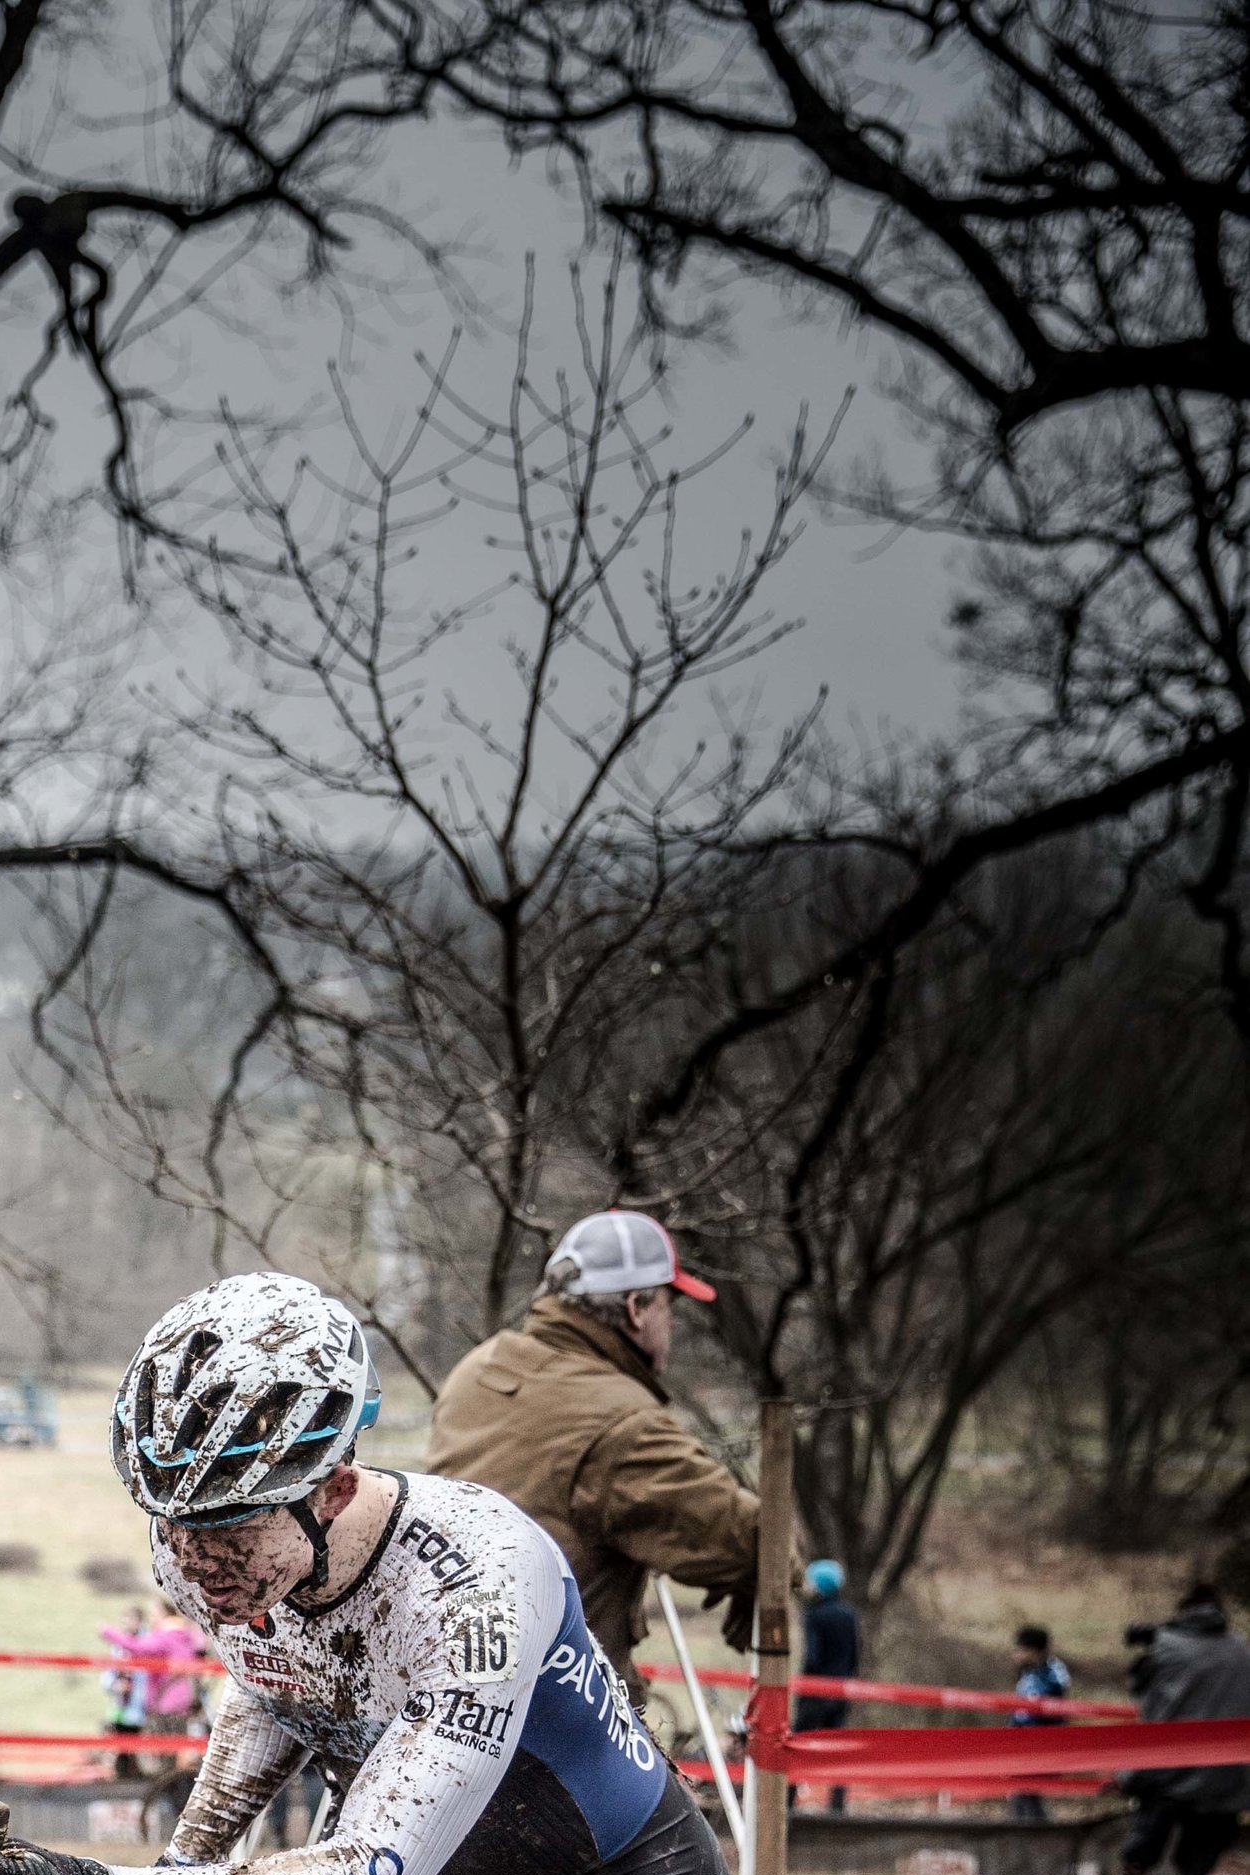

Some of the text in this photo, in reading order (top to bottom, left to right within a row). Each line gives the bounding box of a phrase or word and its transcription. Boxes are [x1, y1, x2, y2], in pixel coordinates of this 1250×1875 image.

[312, 1313, 349, 1383] KASK
[399, 1517, 479, 1591] FOCU
[241, 1636, 288, 1654] PACTIMO
[454, 1614, 508, 1673] 115
[435, 1726, 487, 1754] BAKING
[439, 1688, 514, 1743] Tart
